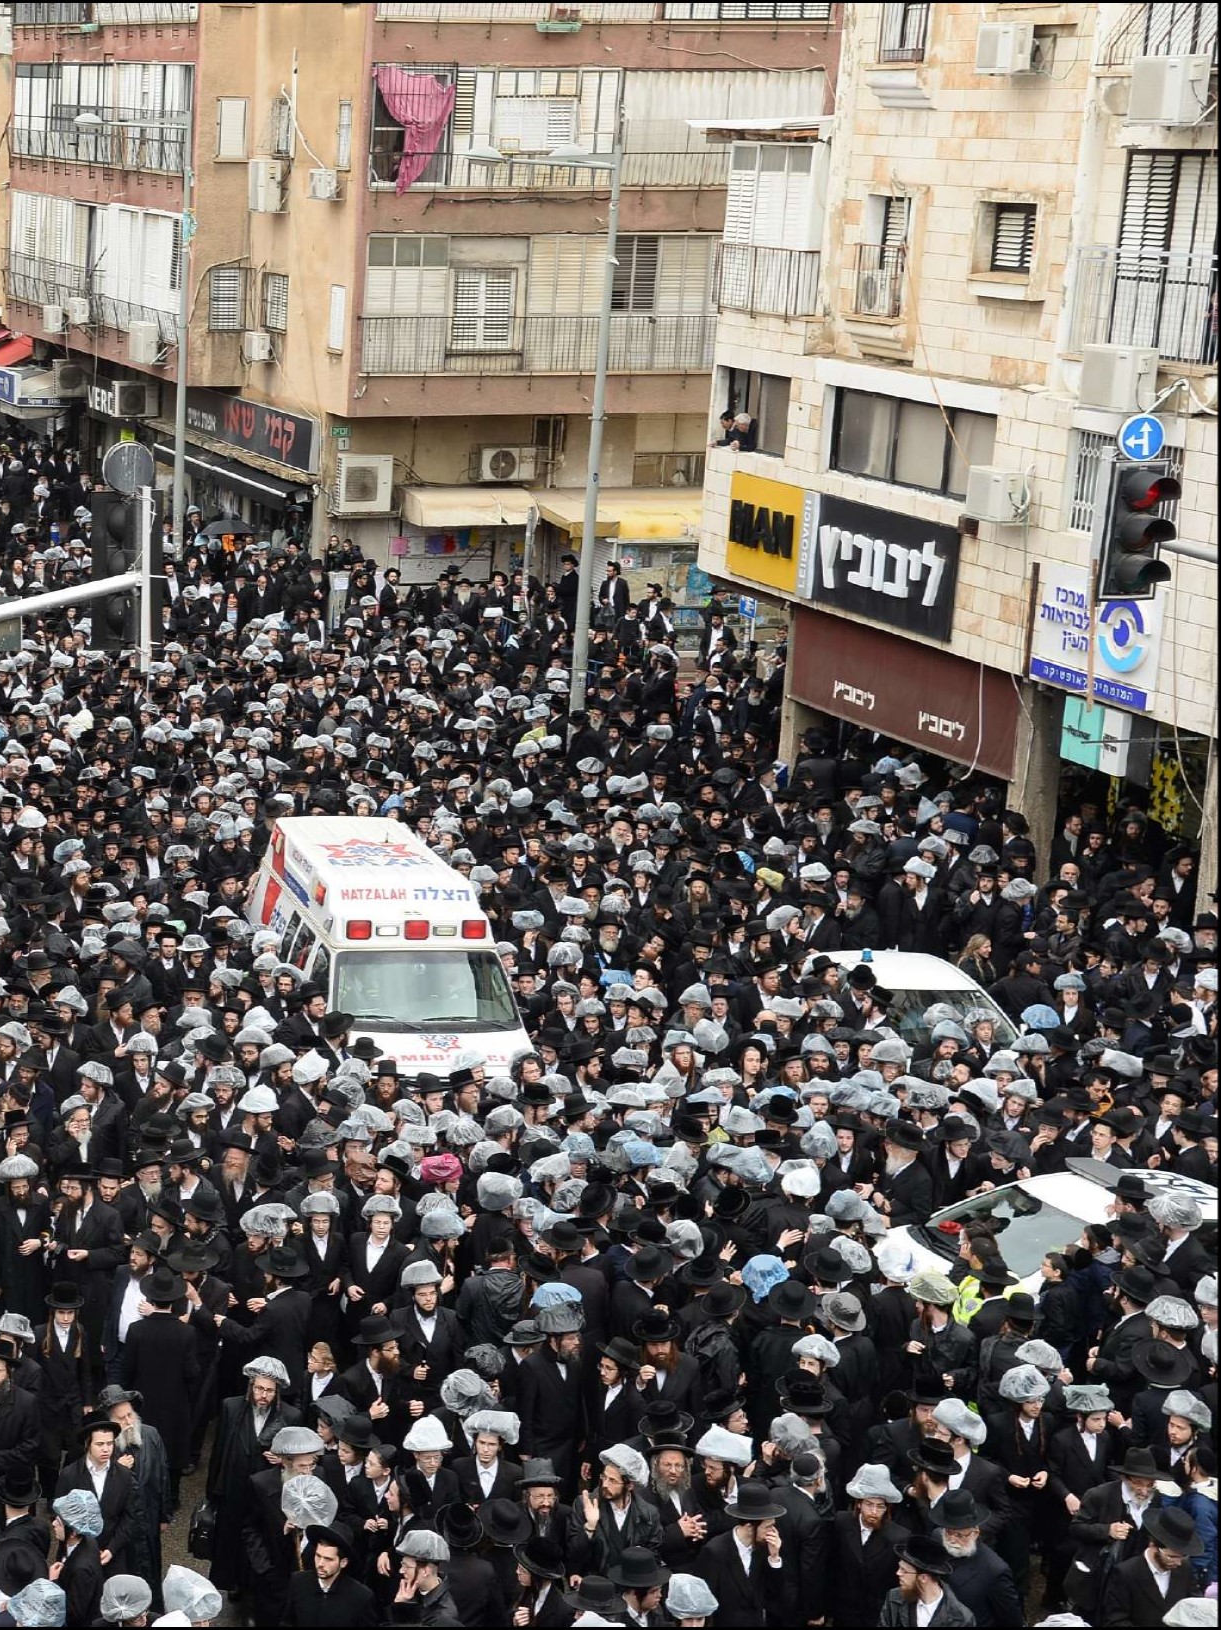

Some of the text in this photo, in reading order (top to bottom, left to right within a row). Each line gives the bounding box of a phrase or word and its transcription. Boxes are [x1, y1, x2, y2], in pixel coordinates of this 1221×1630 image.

[729, 499, 795, 559] MAN
[819, 525, 946, 606] ליבוביץ
[1040, 603, 1090, 631] לבריאות
[1062, 630, 1089, 652] העין
[833, 680, 875, 711] ליבוביץ
[917, 710, 966, 742] ליבוביץ
[340, 888, 407, 900] HATZALAH
[412, 886, 470, 901] הצלה
